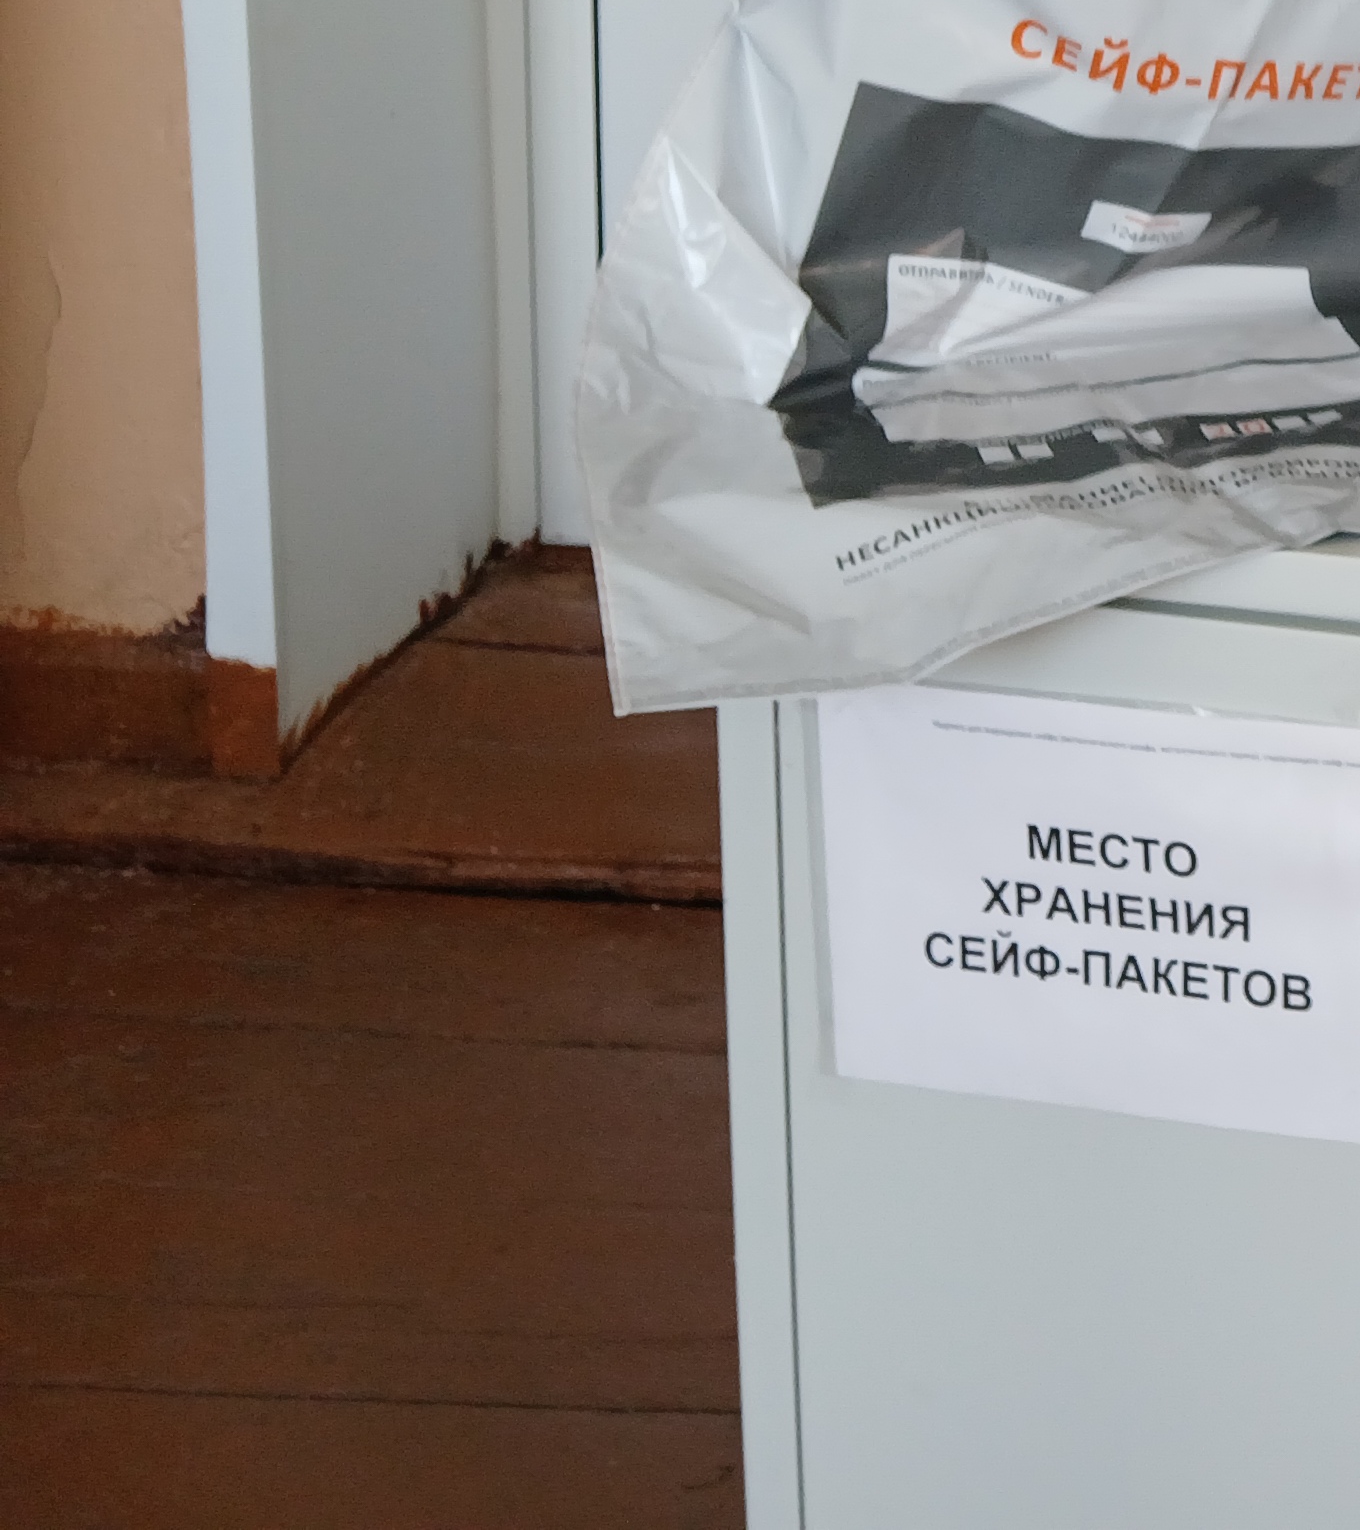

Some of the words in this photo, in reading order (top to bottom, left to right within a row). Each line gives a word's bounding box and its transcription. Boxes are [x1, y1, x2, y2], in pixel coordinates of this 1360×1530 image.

[1026, 823, 1198, 877] МЕСТО
[981, 876, 1251, 943] ХРАНЕНИЯ
[924, 930, 1314, 1013] СЕЙФ-ПАКЕТОВ
